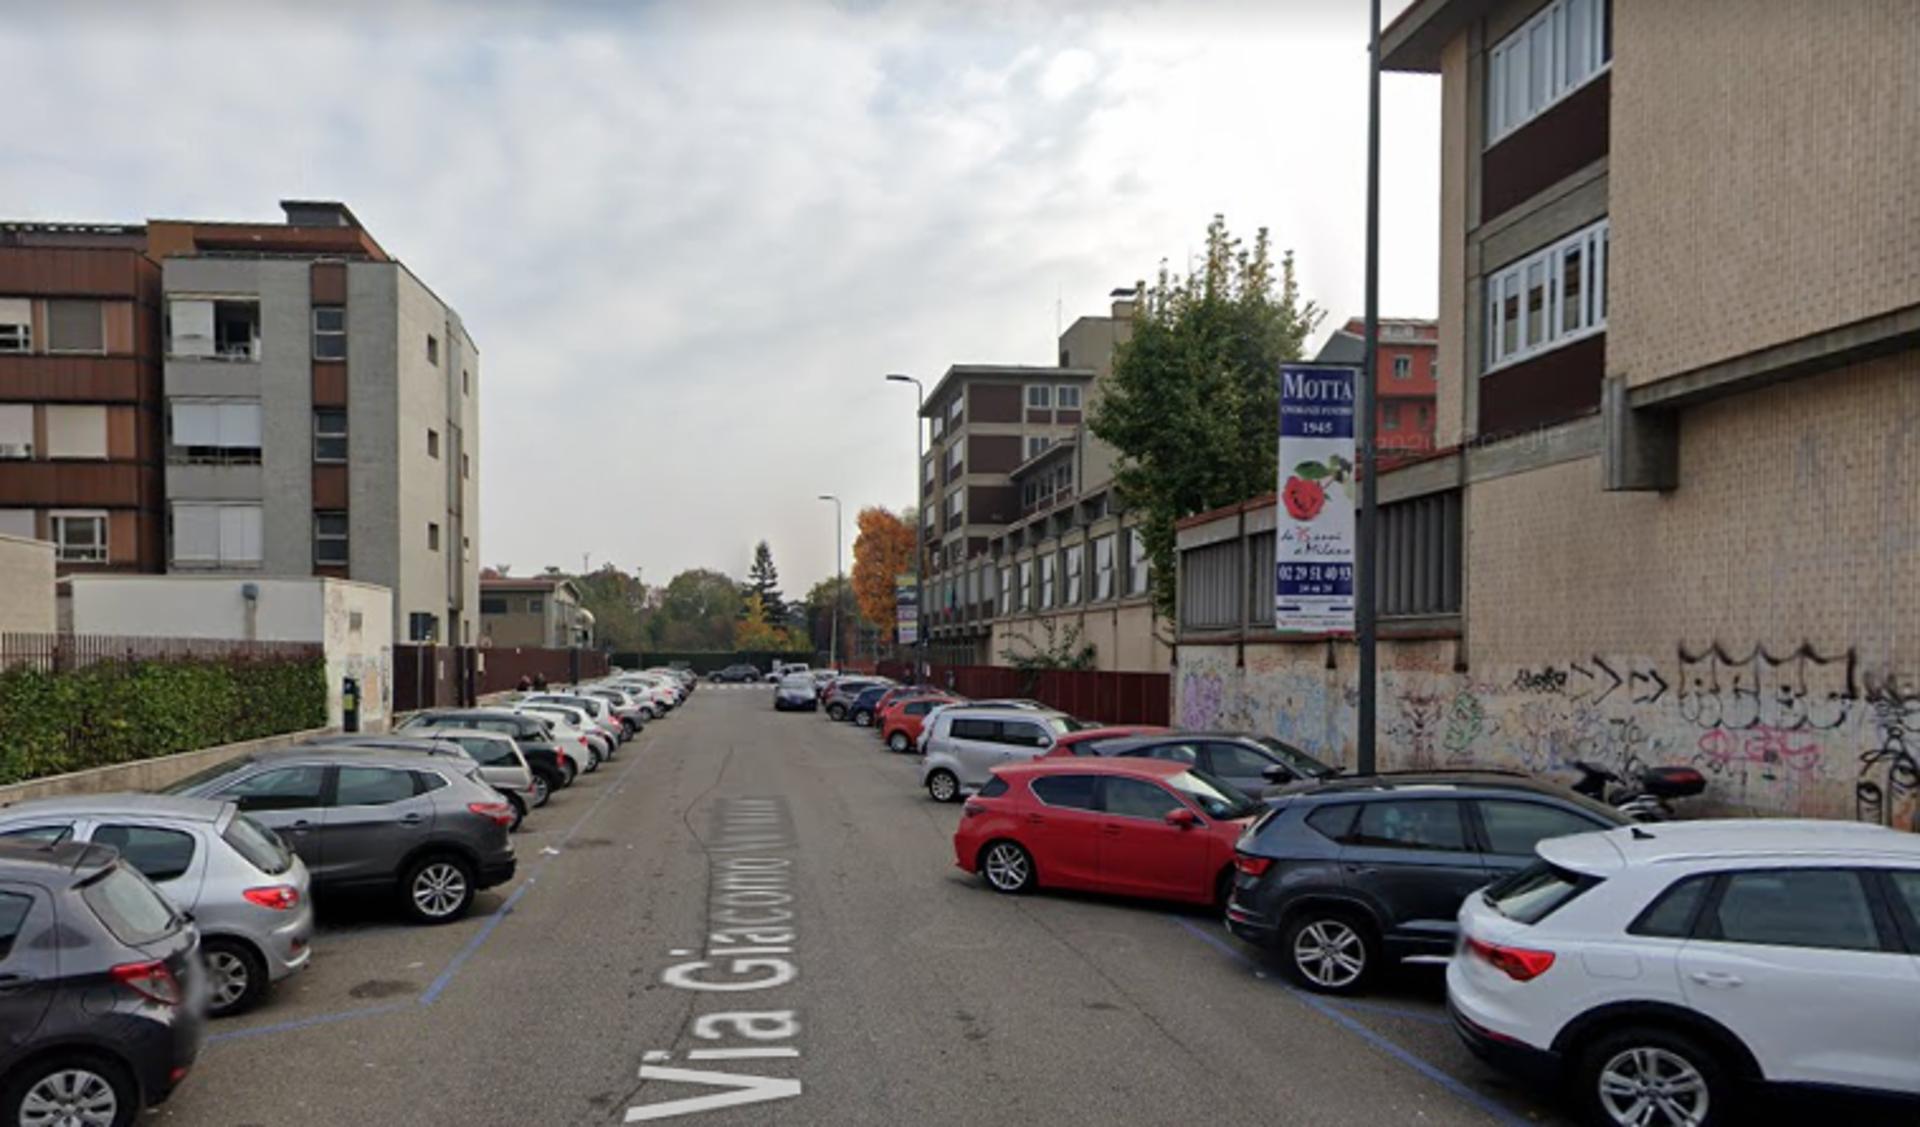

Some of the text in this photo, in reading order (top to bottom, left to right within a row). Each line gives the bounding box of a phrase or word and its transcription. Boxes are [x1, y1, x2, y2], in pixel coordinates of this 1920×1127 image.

[1283, 373, 1353, 400] MOTTA
[1303, 421, 1333, 434] 1945
[1305, 542, 1351, 555] Milano
[1278, 565, 1293, 581] 02
[1294, 565, 1308, 581] 29
[1309, 565, 1322, 581] 51
